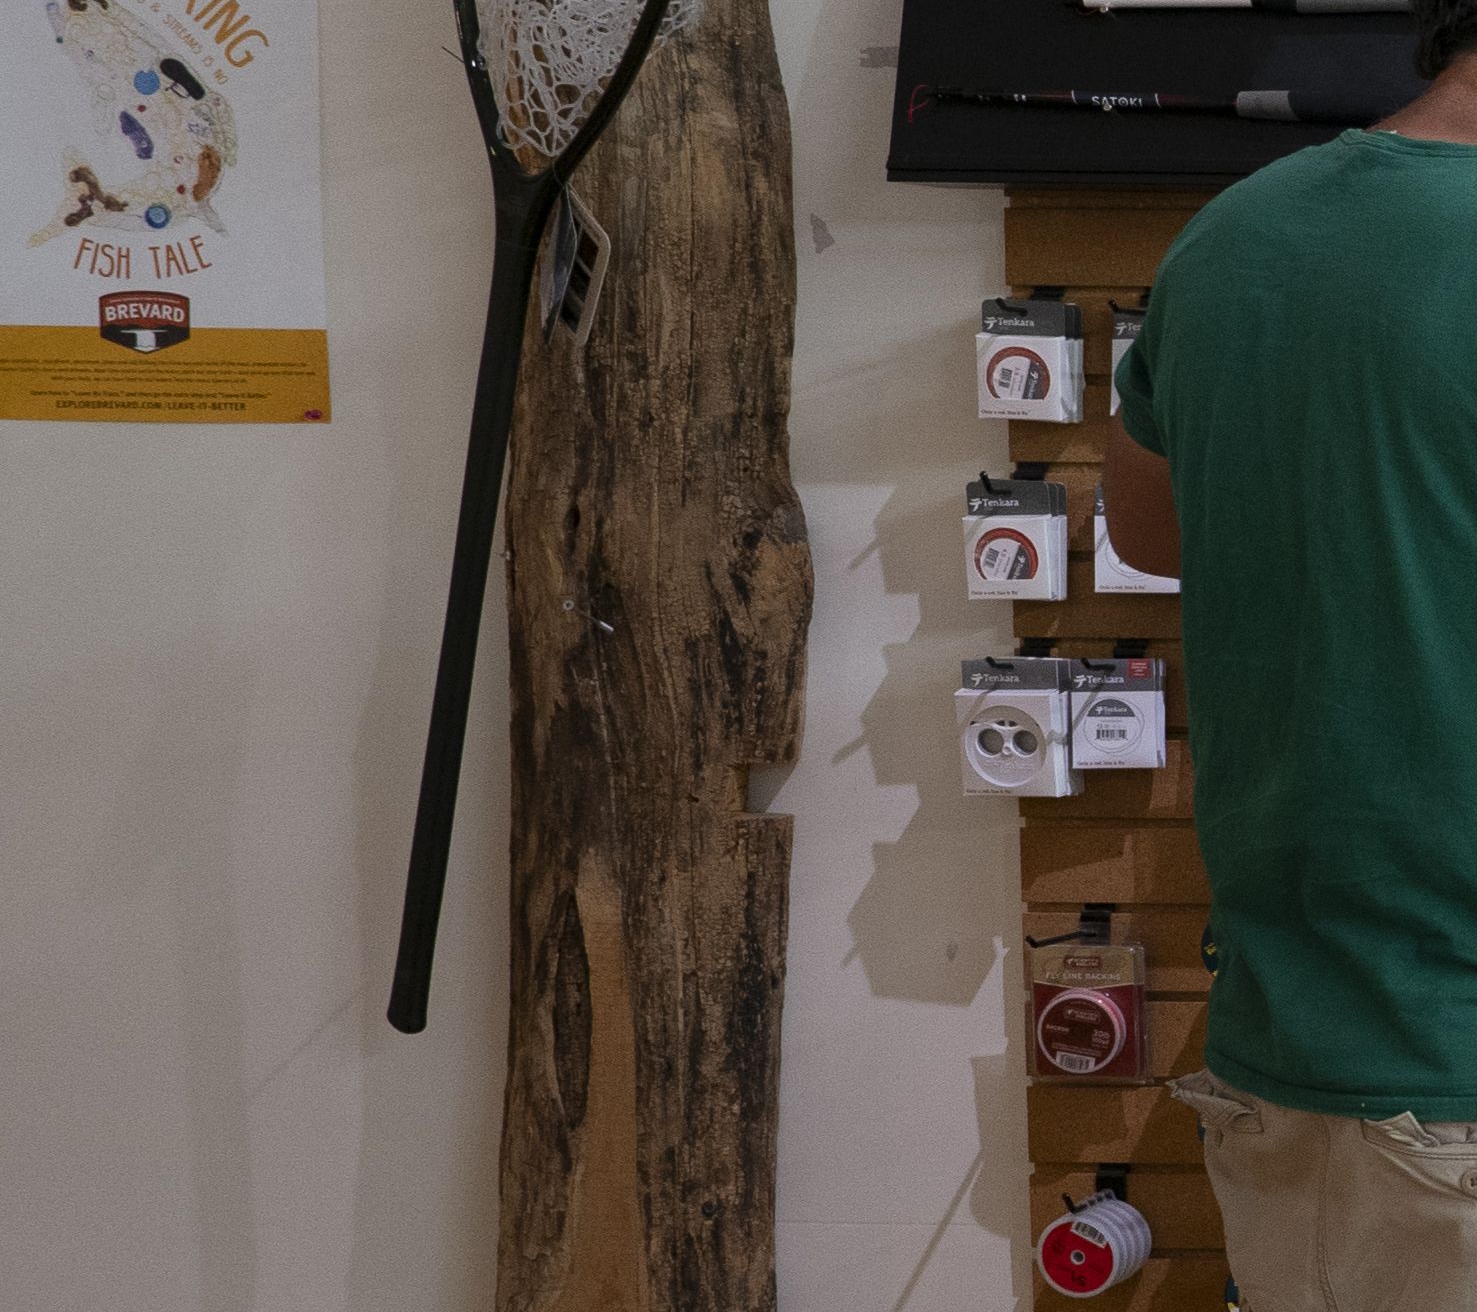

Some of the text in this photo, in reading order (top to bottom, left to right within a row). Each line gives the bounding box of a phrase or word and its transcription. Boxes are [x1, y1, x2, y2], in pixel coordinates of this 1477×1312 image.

[1091, 95, 1143, 107] SATOKI
[74, 235, 213, 280] FISH TALE
[105, 303, 185, 323] BREVARD
